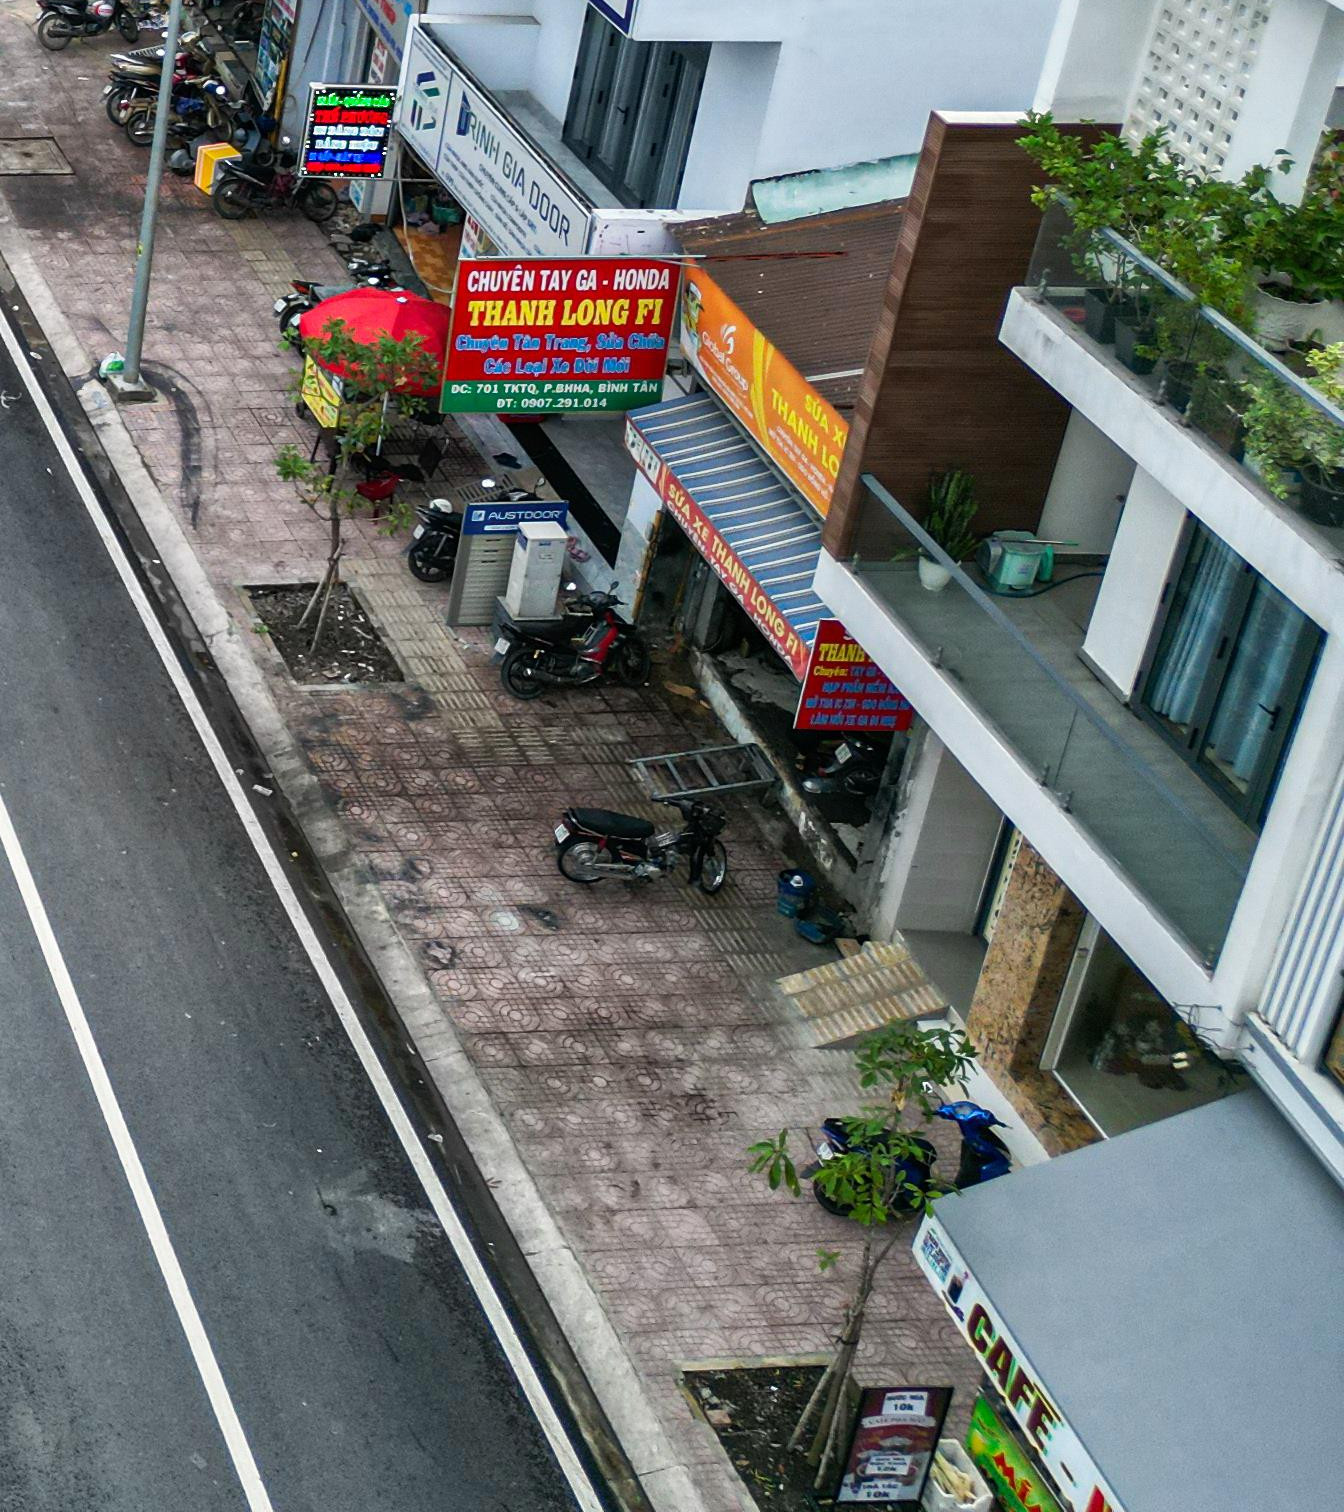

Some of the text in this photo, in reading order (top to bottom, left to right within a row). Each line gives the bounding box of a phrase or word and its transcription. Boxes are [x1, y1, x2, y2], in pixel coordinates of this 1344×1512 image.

[502, 150, 526, 196] GIA
[529, 180, 571, 247] DOOR
[467, 264, 536, 292] CHUYÊN
[539, 270, 574, 292] TAY
[575, 269, 597, 292] GA
[612, 268, 670, 290] HONDA
[468, 298, 664, 327] THANH LONG FI
[455, 333, 509, 353] Chuyên
[483, 357, 512, 375] Các
[515, 357, 548, 377] Loại
[550, 357, 570, 374] Xe
[602, 356, 630, 374] Mới
[476, 384, 498, 394] 701
[504, 383, 539, 396] TKTQ,
[598, 381, 628, 393] BÌNH
[632, 381, 658, 393] TÂN
[497, 397, 607, 410] ĐT: 0907.291.014
[804, 393, 829, 433] SỬA
[771, 388, 819, 455] THANH
[488, 510, 563, 520] AUSTDOOR
[668, 483, 799, 656] SỬA XE THANH LONG FI
